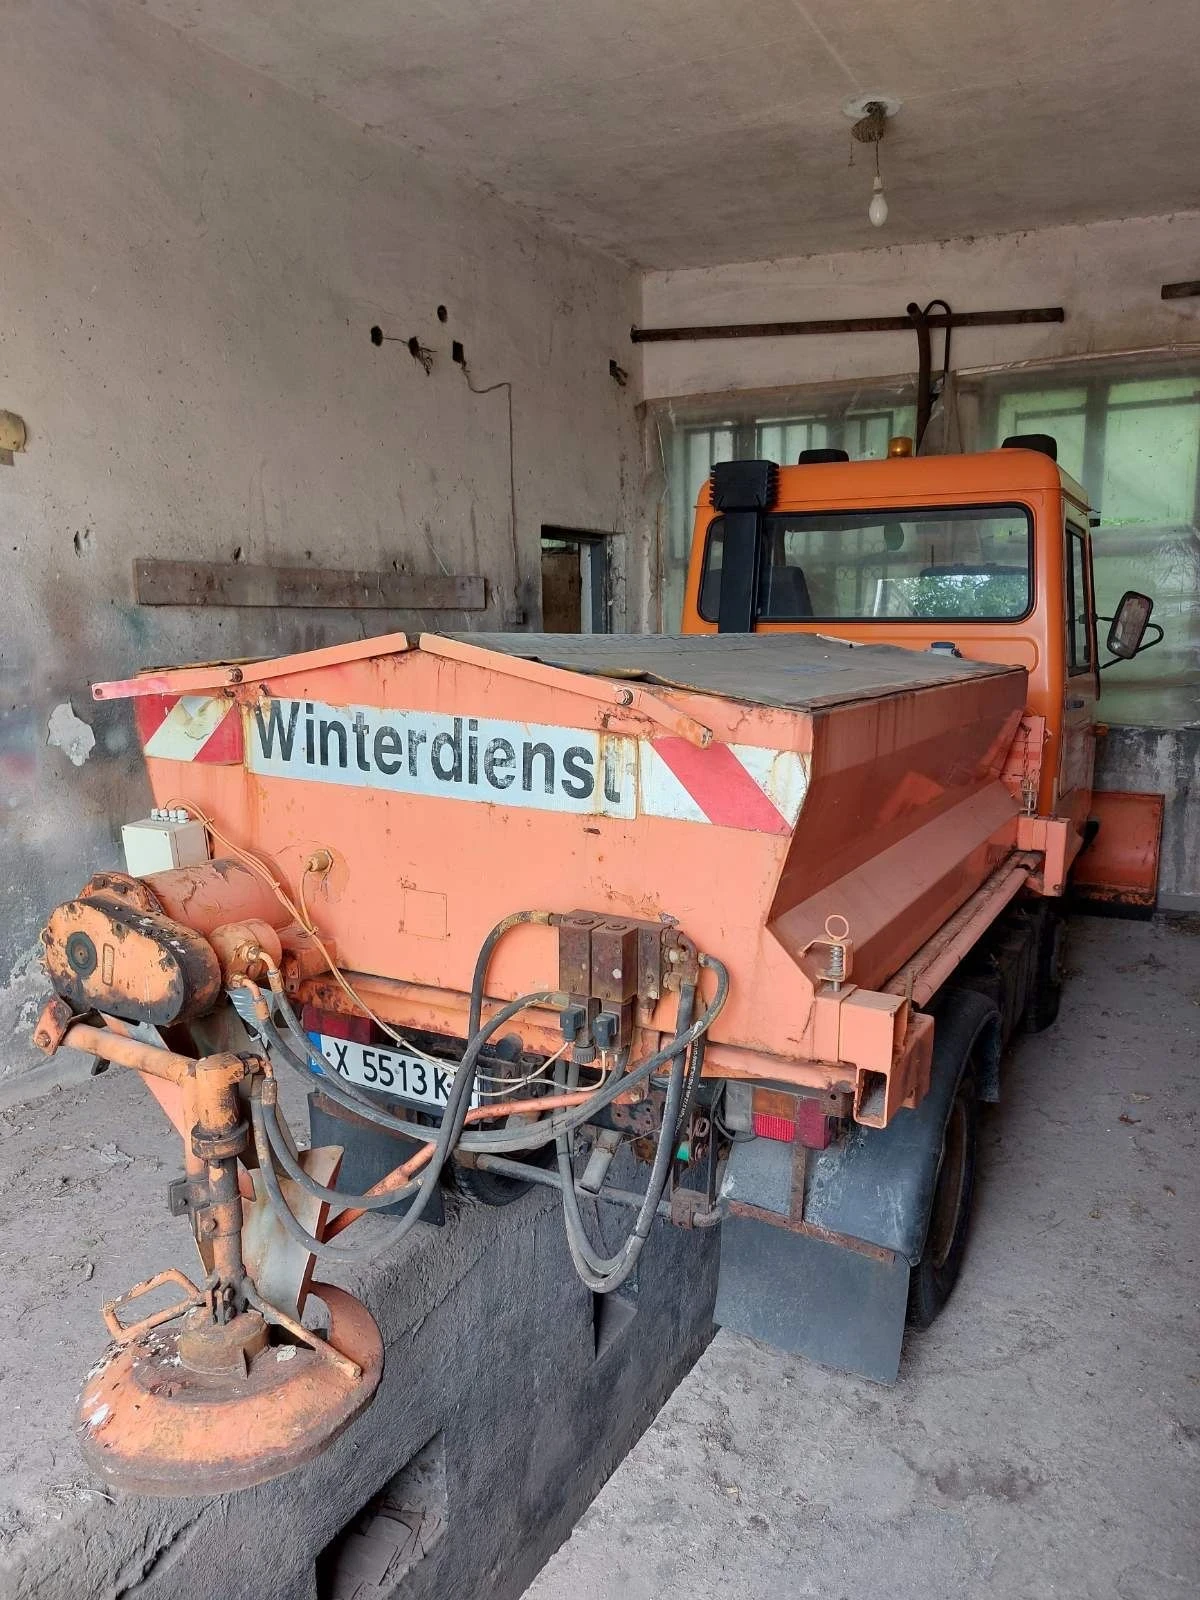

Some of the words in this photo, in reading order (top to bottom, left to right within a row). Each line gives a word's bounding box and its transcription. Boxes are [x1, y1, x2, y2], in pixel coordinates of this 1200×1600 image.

[254, 699, 621, 804] Winterdienst
[334, 1041, 350, 1076] X
[362, 1050, 428, 1096] 5513
